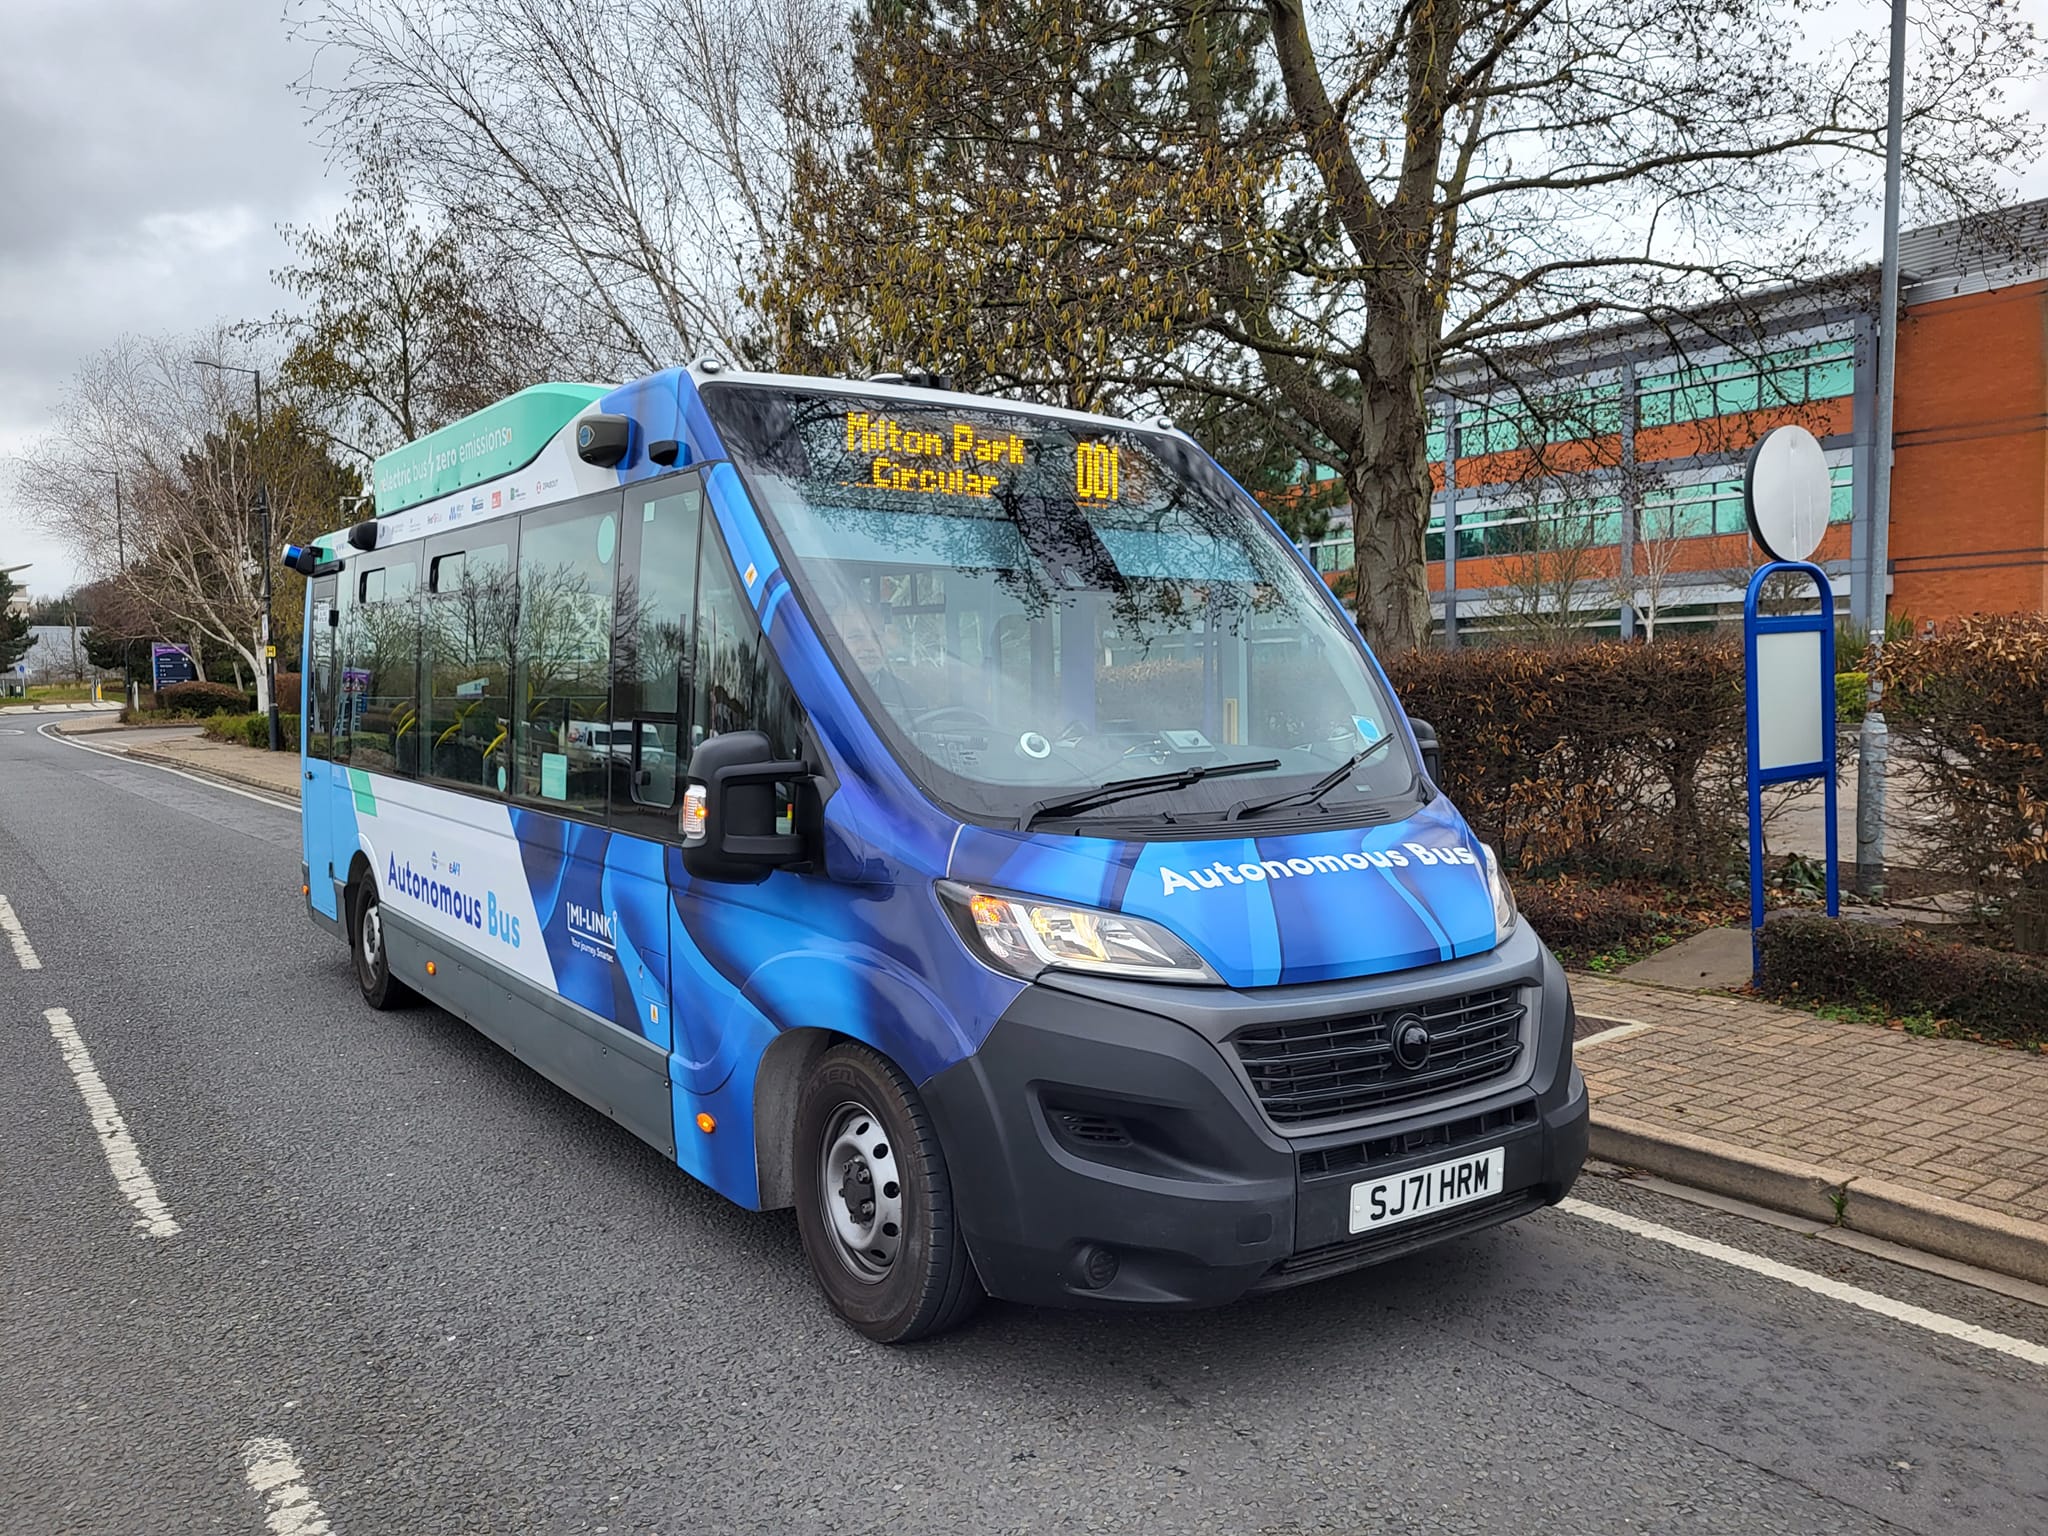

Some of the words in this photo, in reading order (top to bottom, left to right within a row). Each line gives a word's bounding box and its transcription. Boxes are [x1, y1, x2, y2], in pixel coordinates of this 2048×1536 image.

[383, 465, 412, 492] electric
[413, 459, 428, 480] bus
[436, 448, 457, 473] zero
[459, 427, 507, 463] emissions
[847, 412, 942, 456] Milton
[953, 424, 1024, 465] Park
[871, 457, 999, 495] Circular
[1077, 442, 1119, 501] 001
[1159, 844, 1411, 896] Autonomous
[1405, 842, 1476, 867] Bus
[388, 851, 482, 929] Autonomous
[487, 890, 520, 949] Bus
[570, 903, 612, 940] MI-LINK
[1370, 1172, 1432, 1221] SJ71
[1440, 1158, 1490, 1203] HRM
